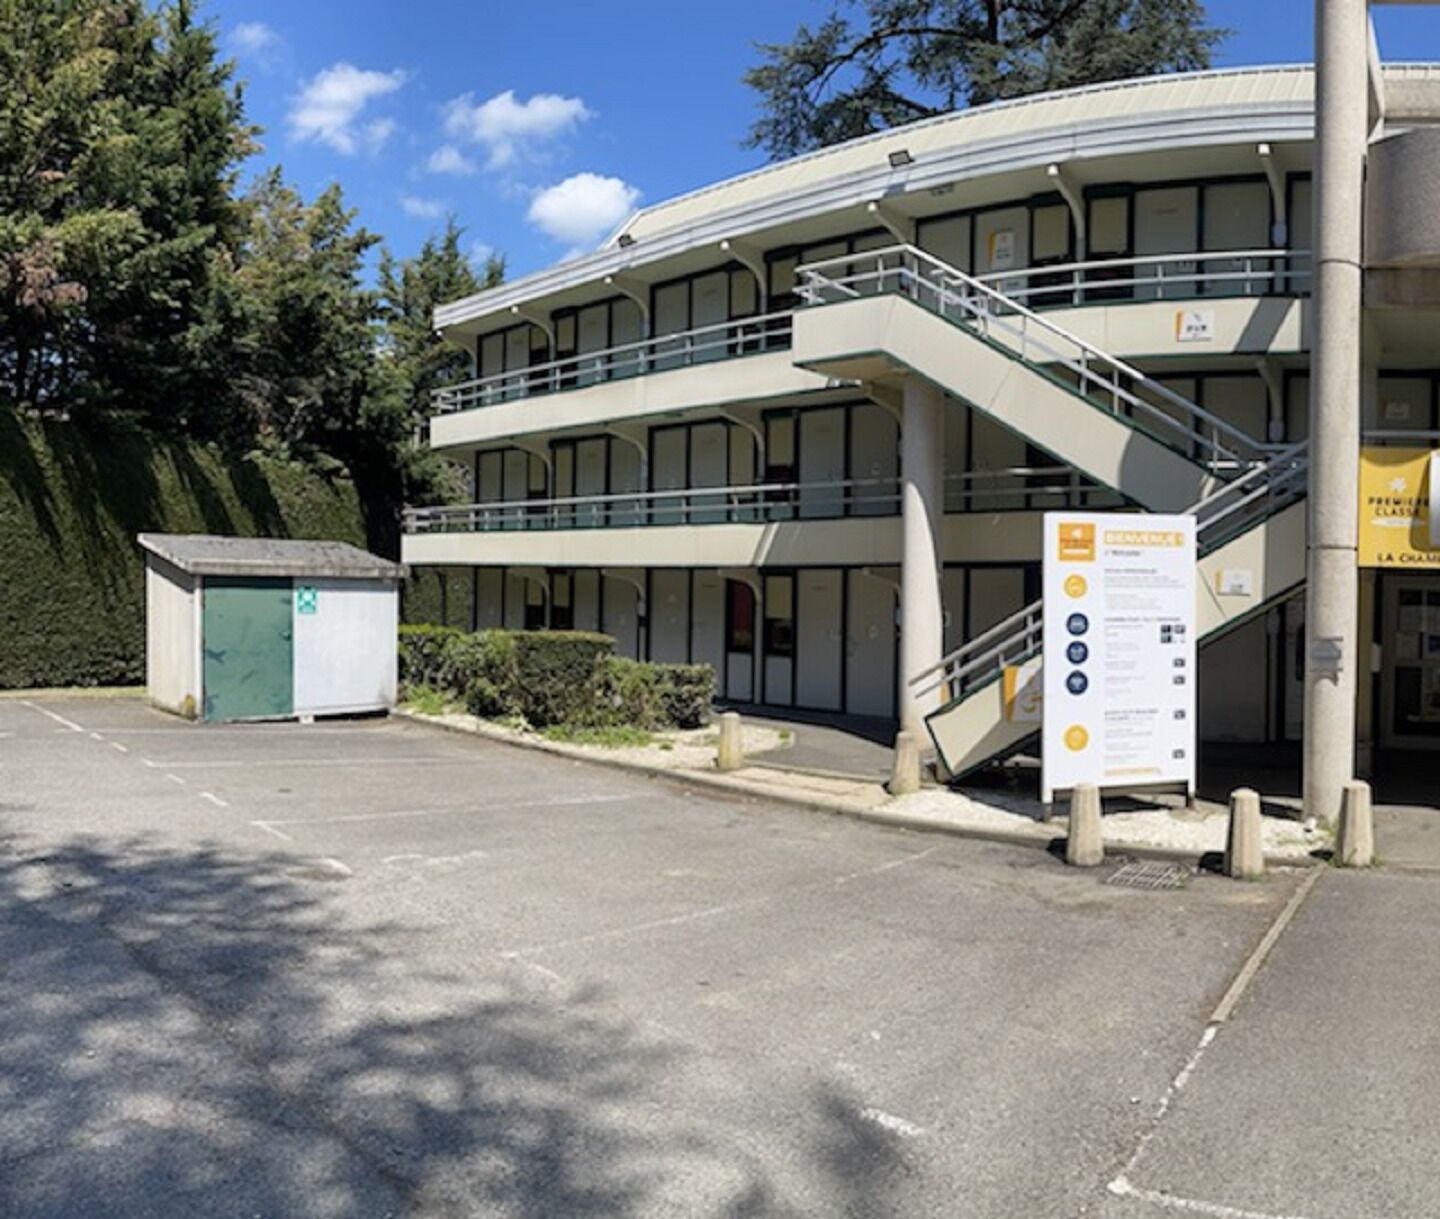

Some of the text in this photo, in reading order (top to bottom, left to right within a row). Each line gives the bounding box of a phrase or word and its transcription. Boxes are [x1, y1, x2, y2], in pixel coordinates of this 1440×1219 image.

[1368, 496, 1430, 507] PREMIERE
[1375, 507, 1420, 517] CLASSE
[1377, 554, 1394, 563] LA
